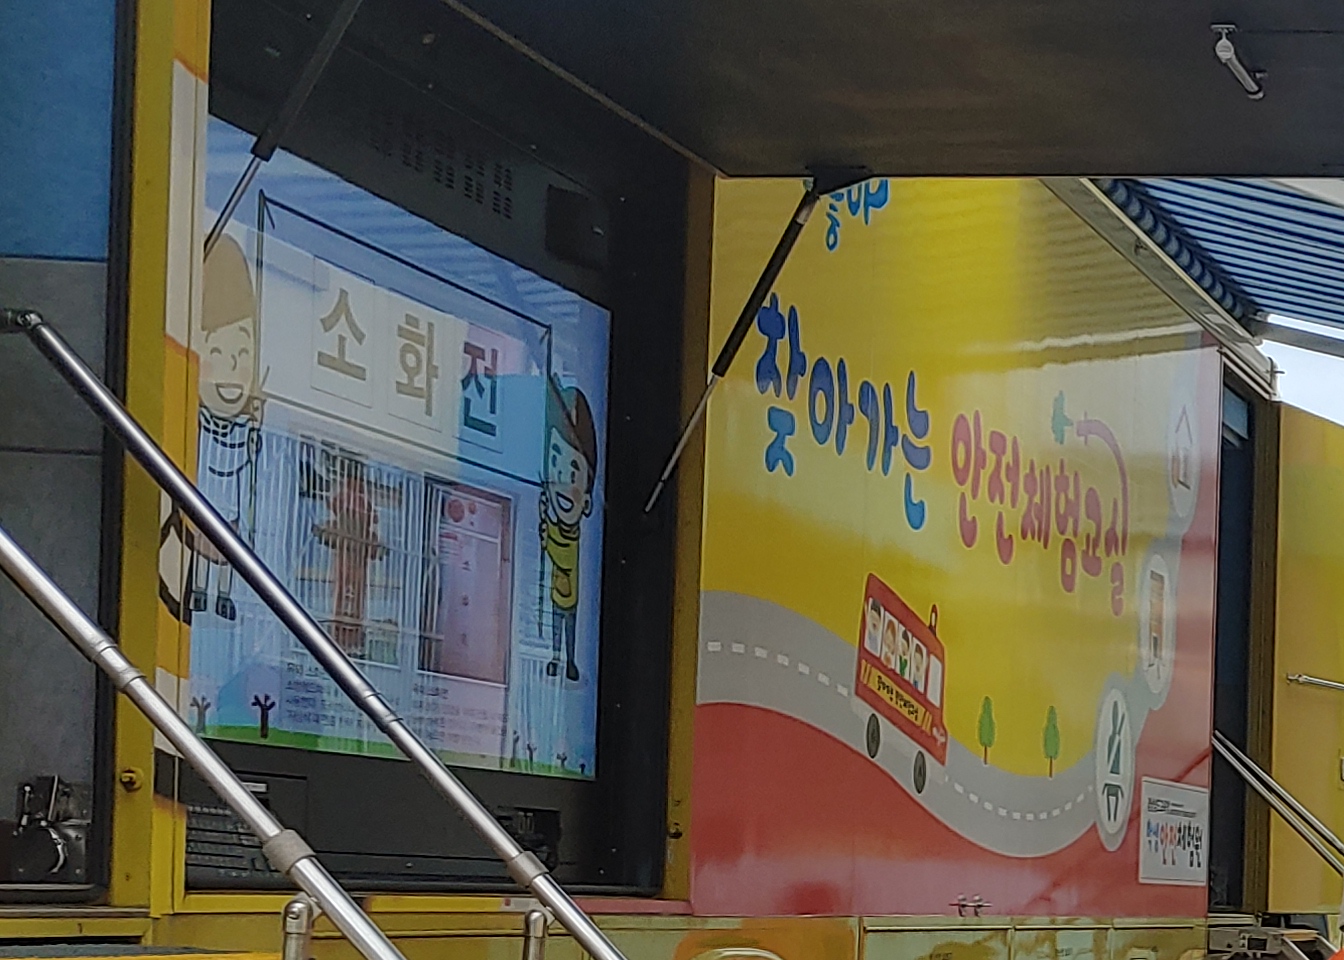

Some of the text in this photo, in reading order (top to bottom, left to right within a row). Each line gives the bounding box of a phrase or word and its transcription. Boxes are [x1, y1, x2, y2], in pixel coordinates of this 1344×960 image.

[317, 288, 498, 437] 소화전
[756, 292, 1129, 617] 찾아가는 안전체험교실
